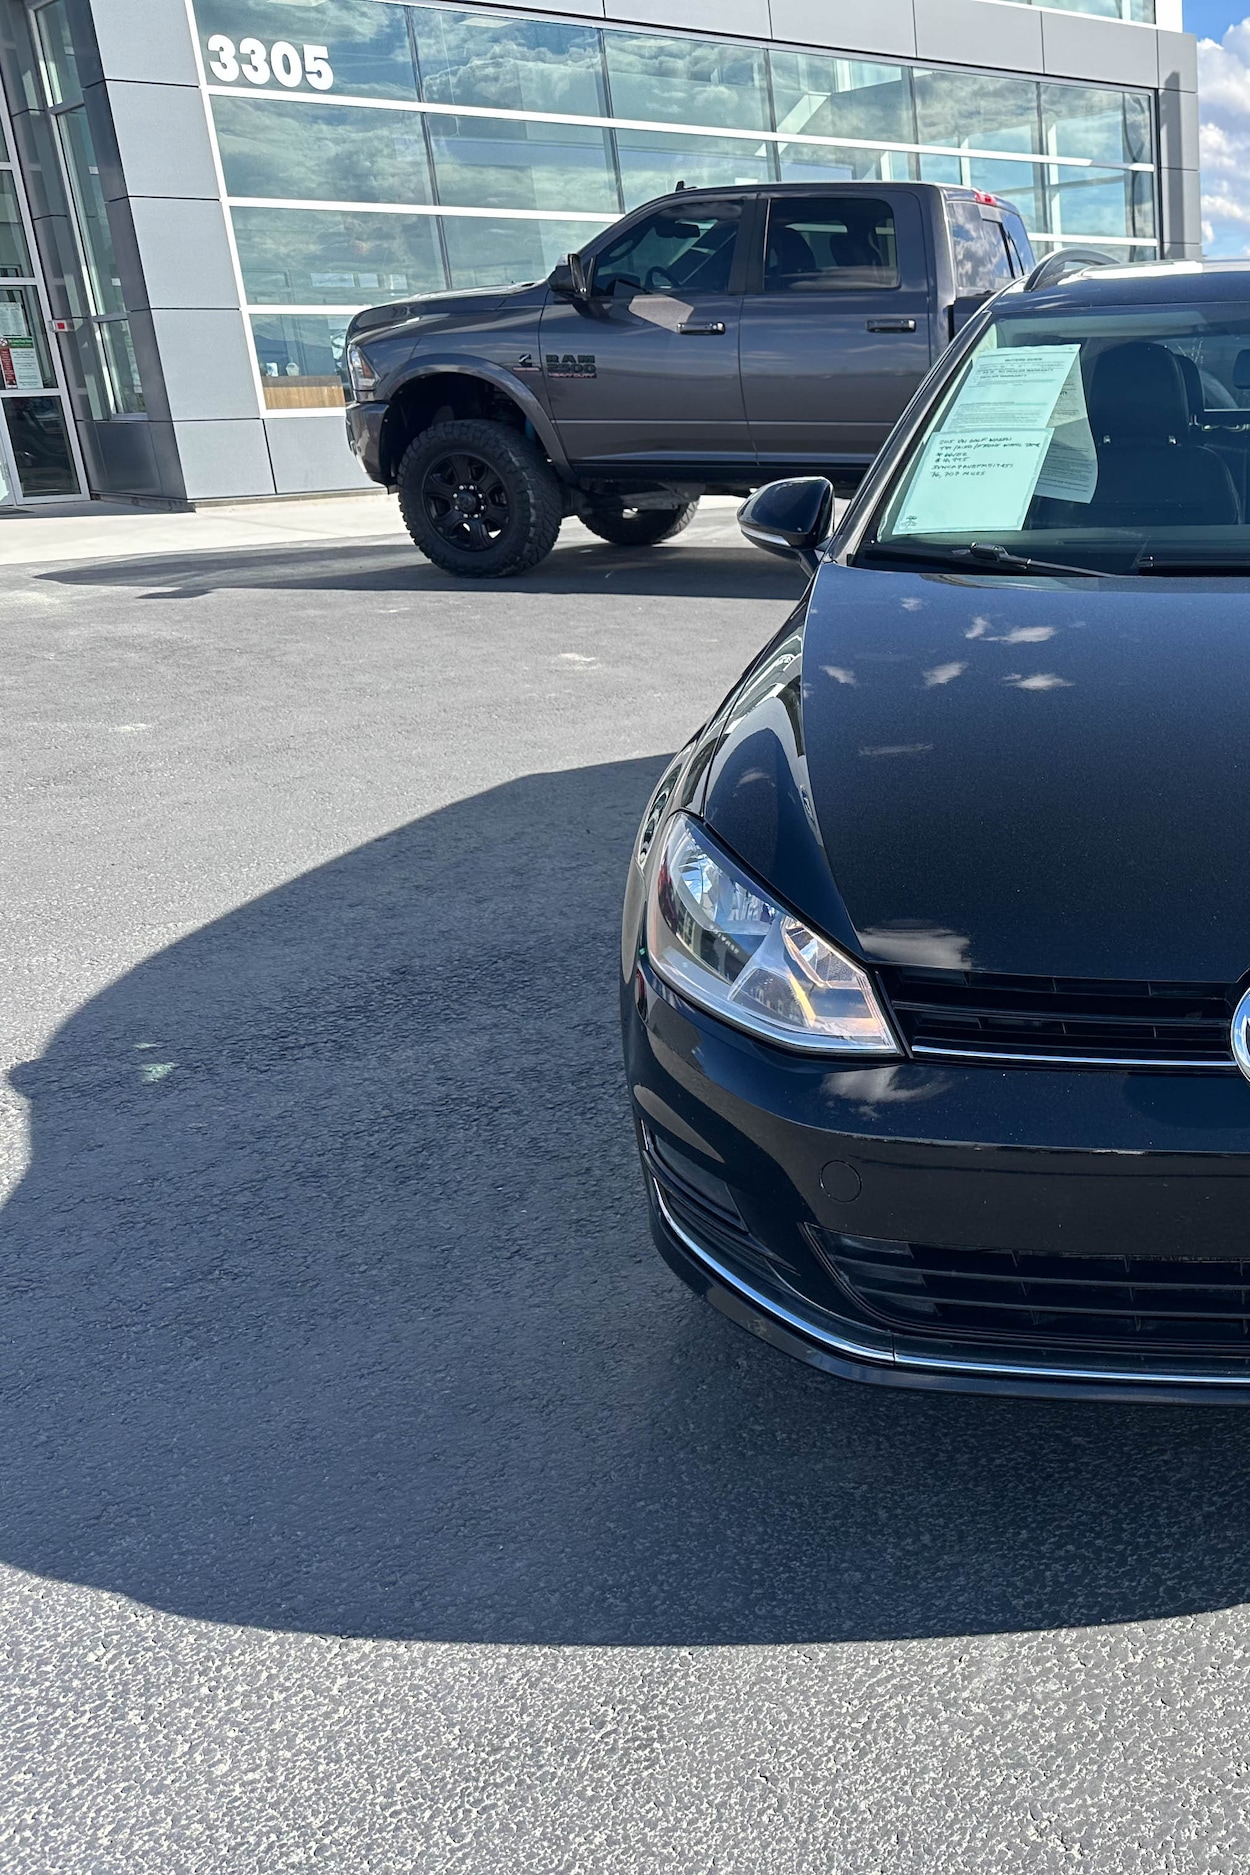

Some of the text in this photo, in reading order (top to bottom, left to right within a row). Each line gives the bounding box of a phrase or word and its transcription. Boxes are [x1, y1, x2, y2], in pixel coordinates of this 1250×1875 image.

[207, 34, 334, 90] 3305
[545, 354, 596, 363] RAM
[547, 363, 597, 374] 2500
